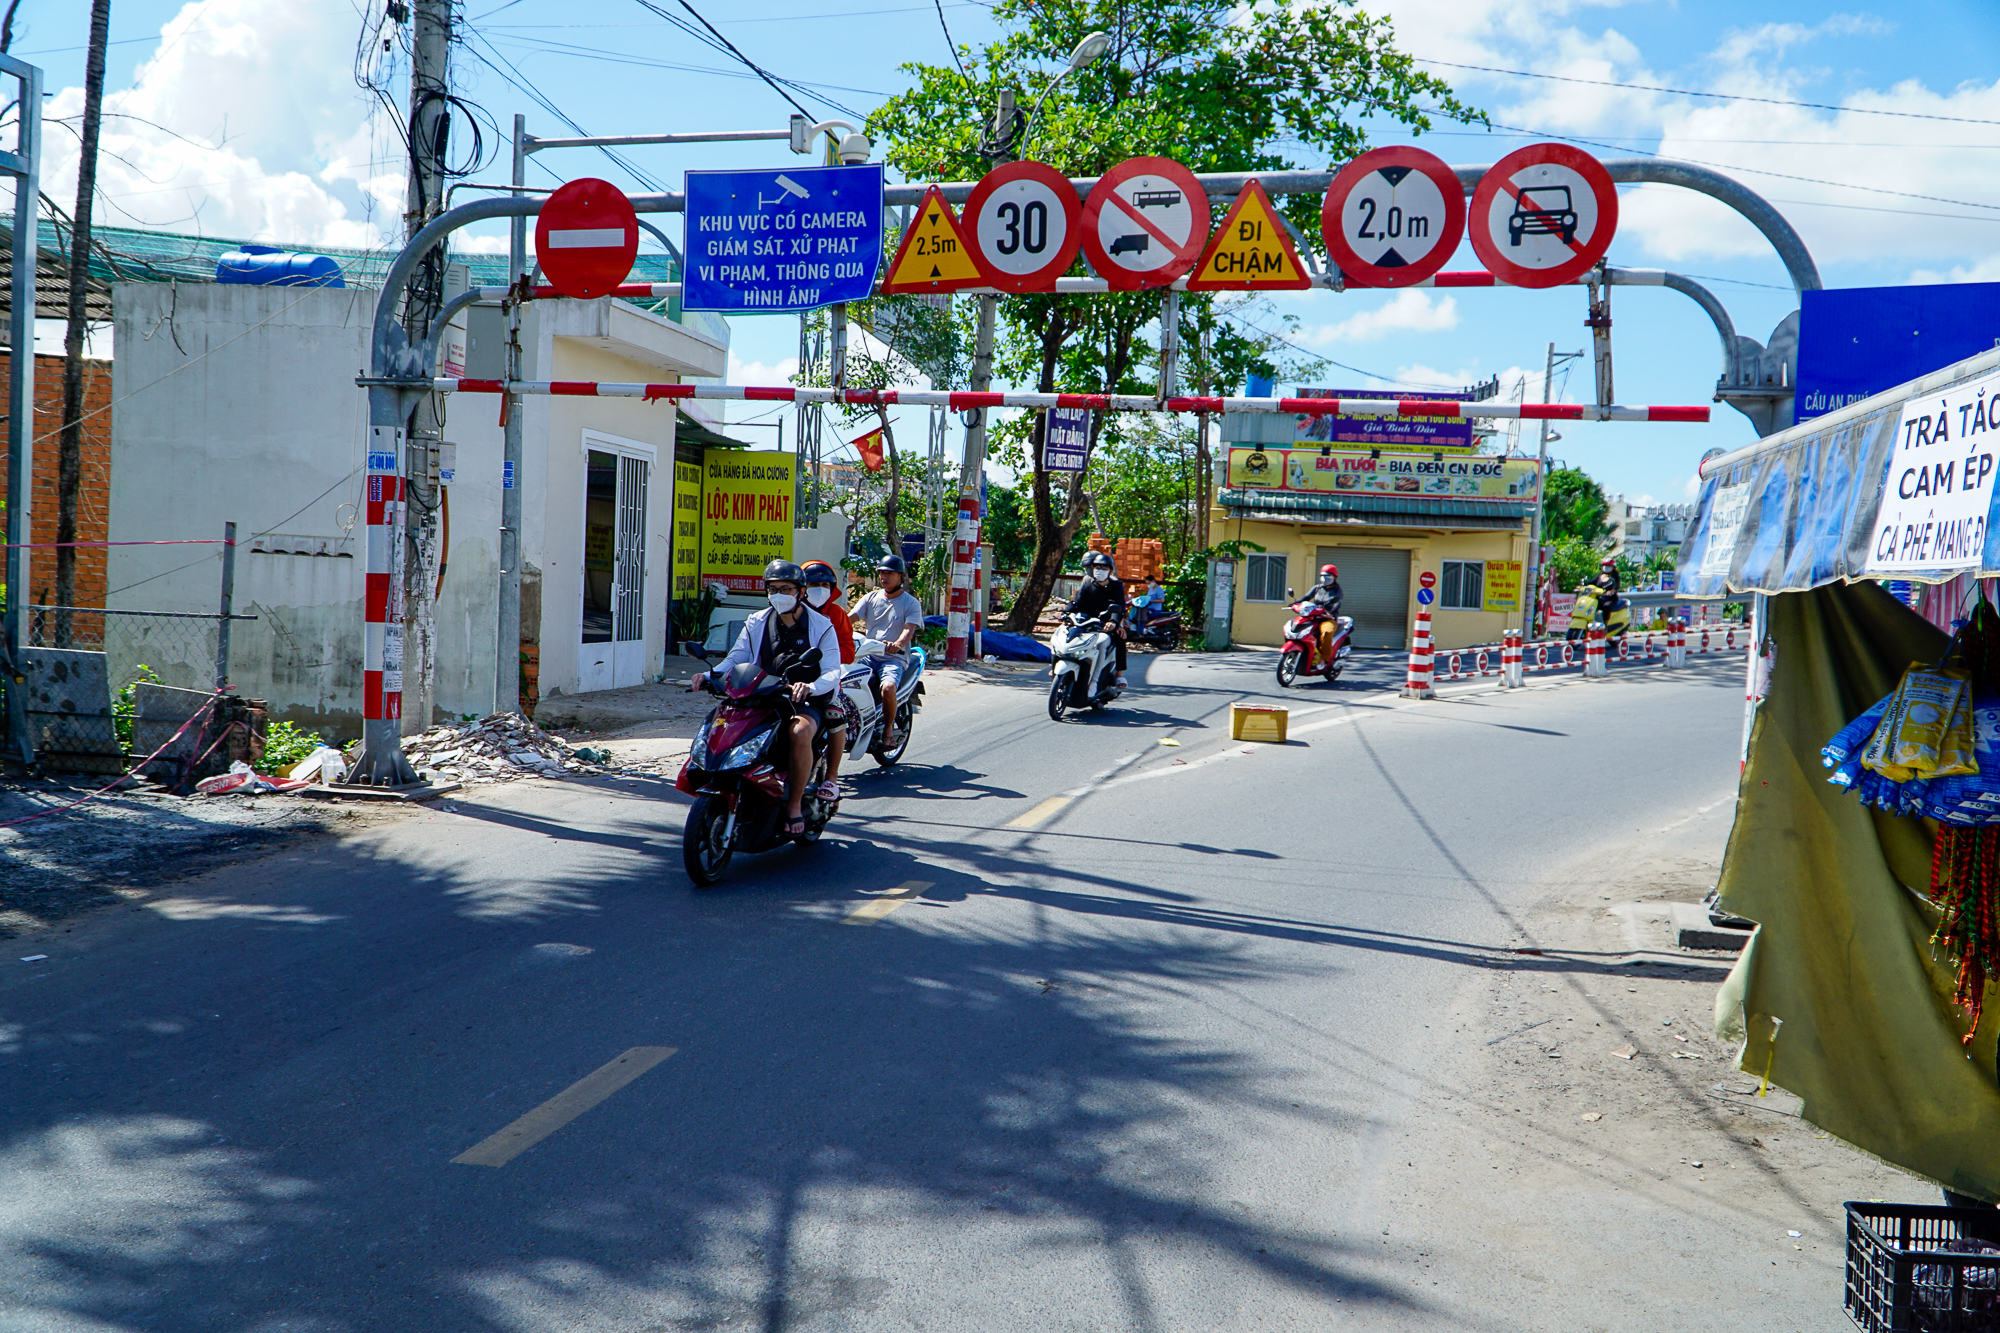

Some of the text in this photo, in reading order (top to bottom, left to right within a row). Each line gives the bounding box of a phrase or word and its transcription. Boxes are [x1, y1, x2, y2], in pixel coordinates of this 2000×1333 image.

[700, 210, 867, 234] KHU VỰC CÓ CAMERA
[996, 201, 1047, 255] 30
[1238, 220, 1263, 242] ĐI
[707, 236, 749, 257] GIÁM
[790, 233, 813, 255] XỬ
[818, 236, 859, 257] PHẠT
[916, 236, 956, 257] 2,5m
[699, 260, 864, 284] VI PHẠM, THÔNG QUA
[1213, 248, 1283, 279] CHẬM
[743, 284, 820, 307] HÌNH ẢNH
[1805, 389, 1827, 411] CẦU
[1828, 394, 1844, 411] AN
[1386, 423, 1411, 433] Bình
[1905, 399, 1950, 450] TRÀ
[1050, 425, 1085, 447] MẶT BẰNG
[709, 459, 789, 481] CỬA HÀNG ĐÁ HOA CƯƠNG
[1315, 457, 1340, 471] BIA
[1342, 457, 1377, 472] TƯƠI
[1389, 460, 1412, 473] BIA
[1416, 461, 1445, 475] ĐEN
[1448, 462, 1469, 475] CN
[1472, 459, 1503, 477] ĐỨC
[1898, 443, 1993, 500] CAM ÉP
[706, 487, 790, 525] LỘC KIM PHÁT
[732, 533, 747, 545] CUNG
[747, 529, 758, 545] CẤP
[761, 534, 769, 546] THI
[769, 532, 784, 547] CÔNG
[1900, 508, 1934, 561] PHÊ
[1932, 517, 1973, 560] MANG
[1972, 515, 1985, 557] Đ
[708, 548, 718, 564] CẤP
[721, 548, 730, 565] BẾP
[744, 553, 760, 566] THANG
[1487, 561, 1504, 571] Quán
